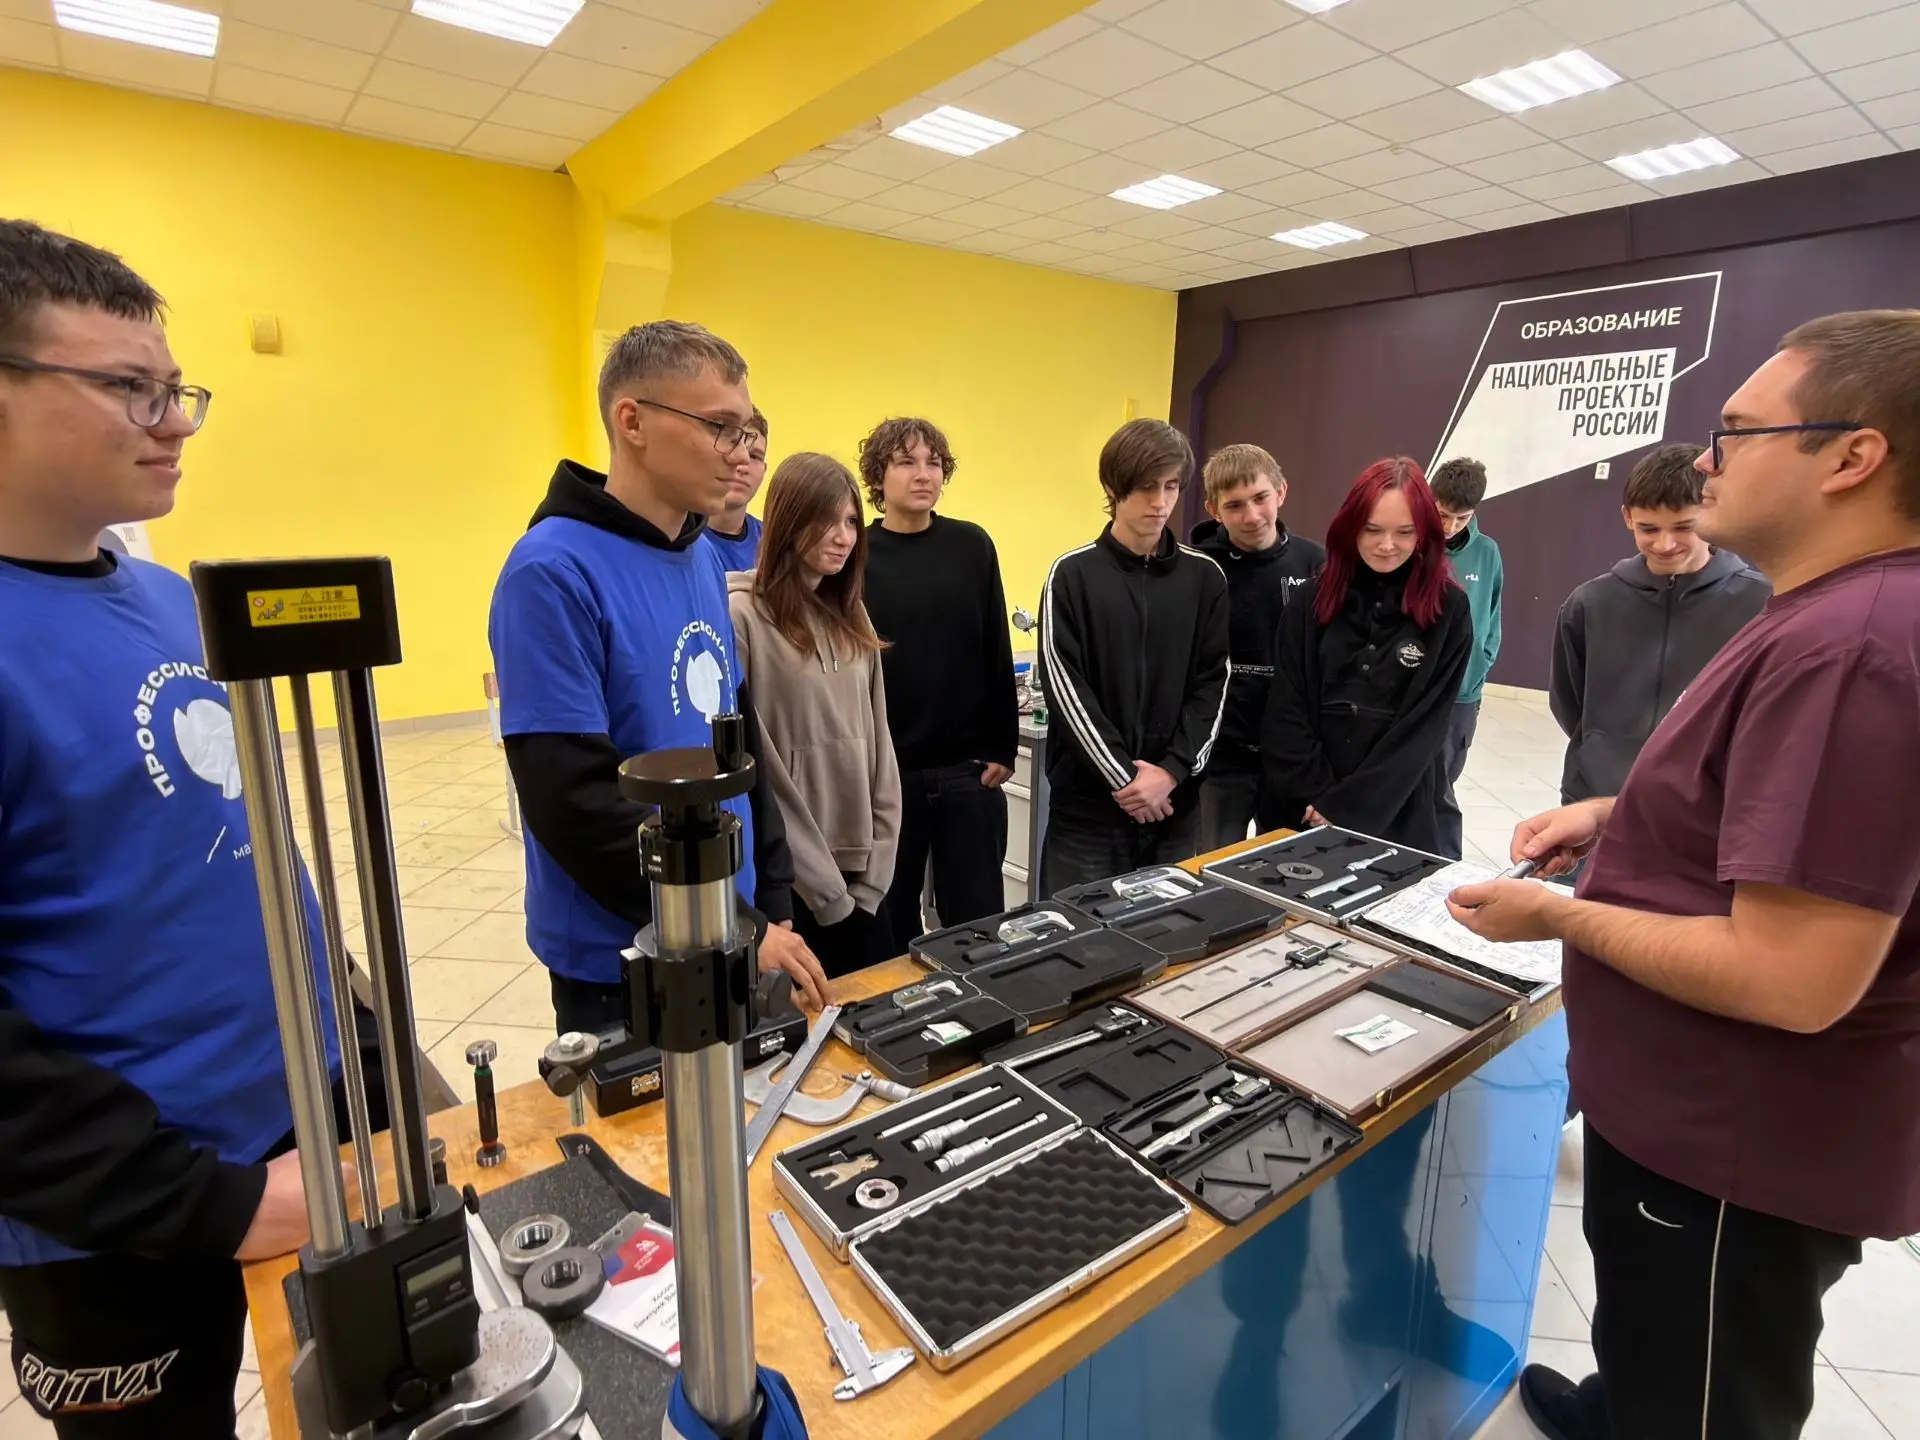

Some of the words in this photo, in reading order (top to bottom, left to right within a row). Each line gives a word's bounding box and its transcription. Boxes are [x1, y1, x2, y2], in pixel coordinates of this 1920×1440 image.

[1520, 306, 1683, 340] ОБРАЗОВАНИЕ
[1491, 353, 1669, 390] НАЦИОНАЛЬНЫЕ
[1558, 382, 1664, 412] ПРОЕКТЫ
[1572, 410, 1659, 437] РОССИИ
